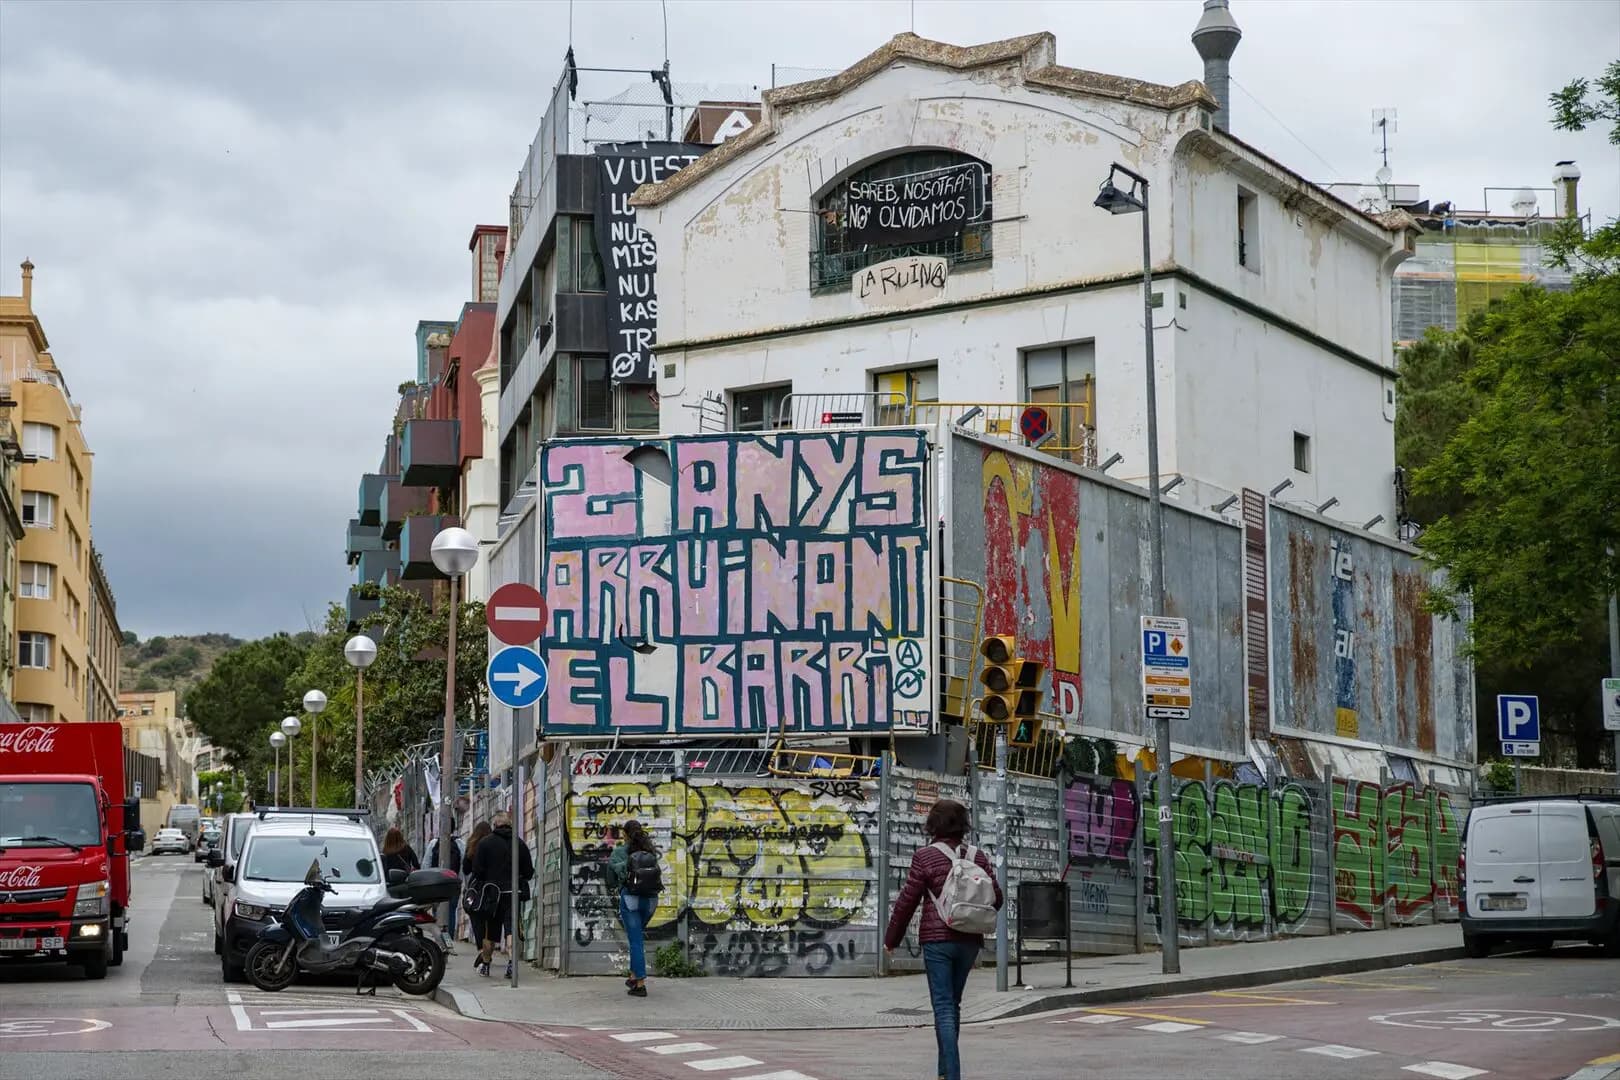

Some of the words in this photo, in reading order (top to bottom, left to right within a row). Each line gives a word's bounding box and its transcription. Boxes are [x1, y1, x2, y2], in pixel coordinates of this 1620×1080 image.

[618, 273, 657, 298] NU
[673, 430, 926, 535] ANYS
[1149, 632, 1161, 653] P
[545, 643, 669, 731] EL
[1507, 701, 1531, 736] P
[44, 938, 64, 948] SP
[1414, 1012, 1567, 1028] 30
